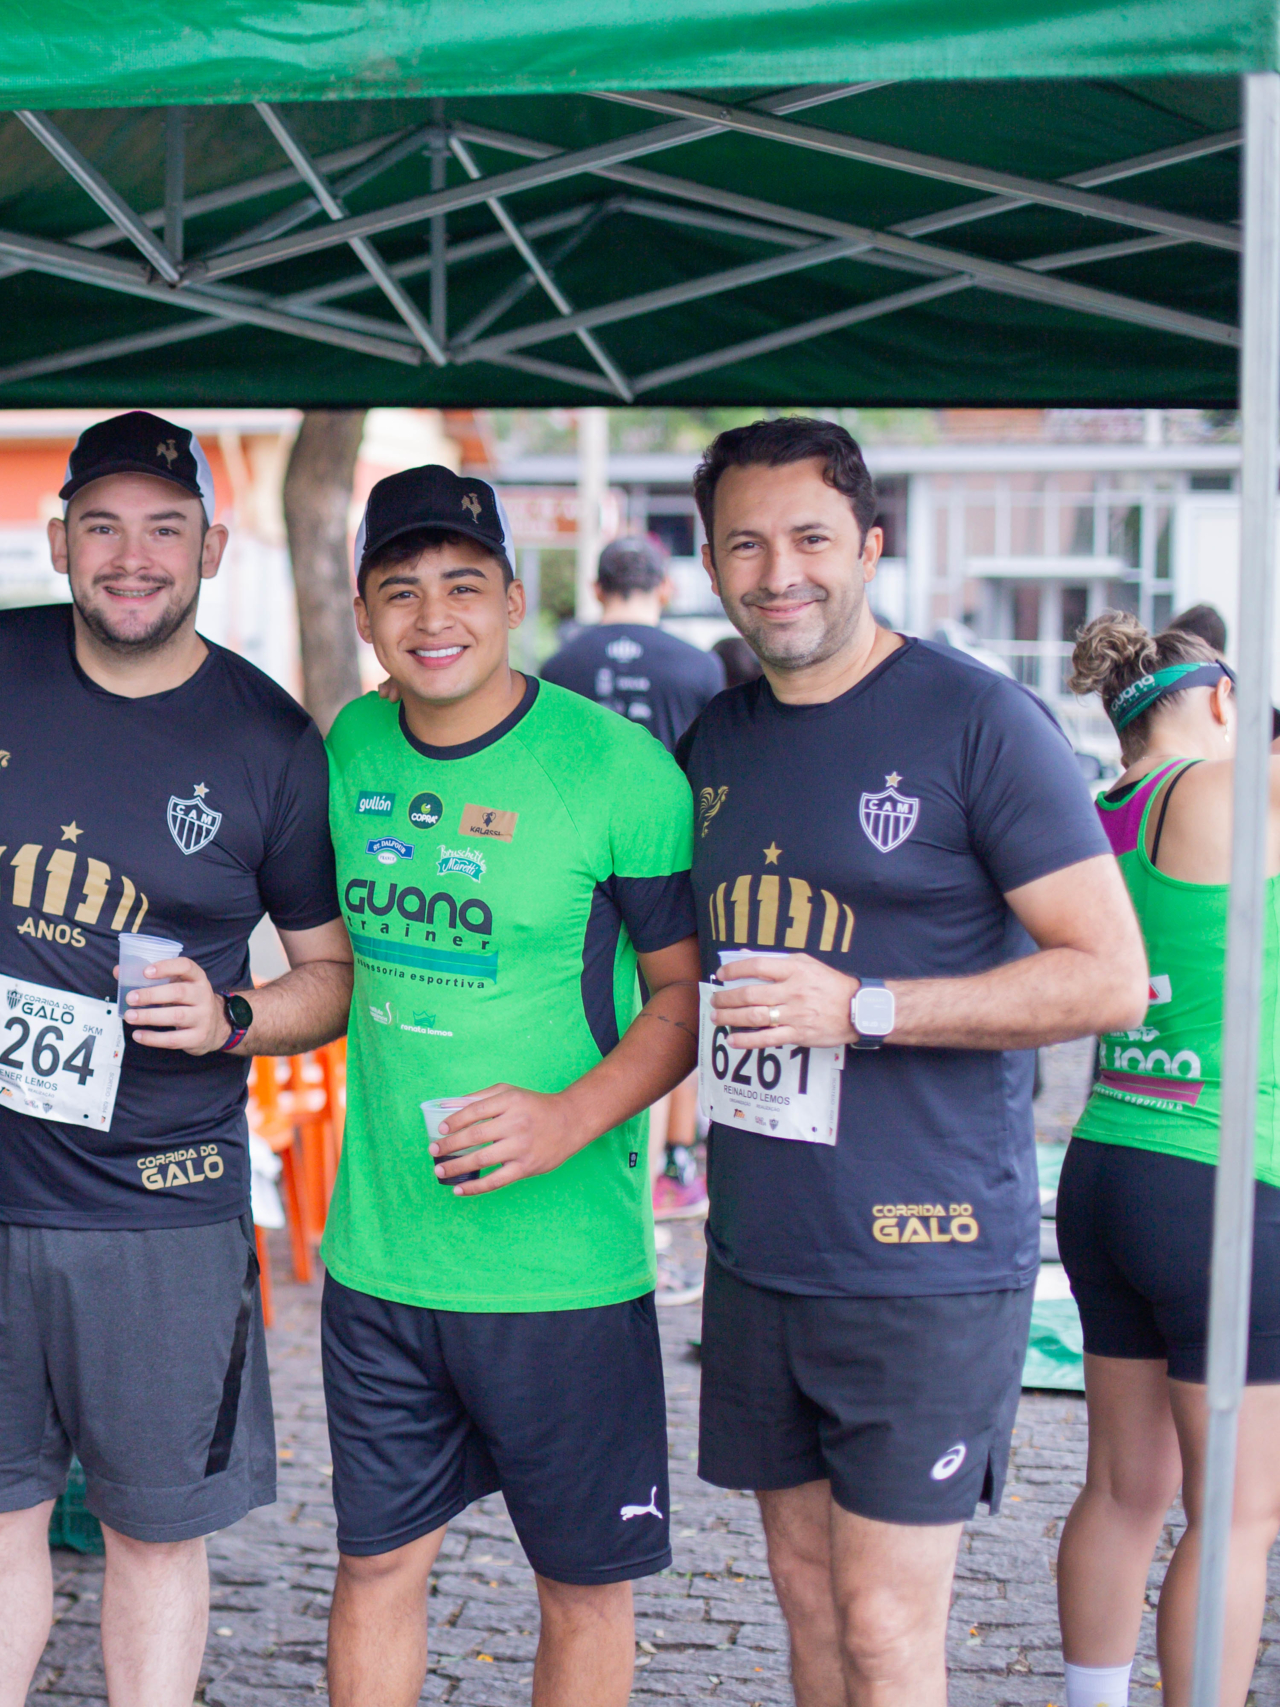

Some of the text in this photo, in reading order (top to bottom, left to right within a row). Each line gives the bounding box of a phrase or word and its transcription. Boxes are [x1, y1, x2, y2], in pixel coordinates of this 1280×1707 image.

[175, 804, 213, 825] CAM
[359, 795, 392, 814] gullón
[868, 798, 911, 815] CAM
[381, 840, 406, 855] DALFOUR
[17, 917, 87, 948] ANOS
[346, 914, 491, 950] trainer
[410, 973, 486, 989] esportiva
[21, 1001, 76, 1025] GALO
[23, 994, 75, 1012] CORRIDA DO
[82, 1024, 104, 1036] 5KM
[711, 1025, 812, 1095] 6261
[24, 1076, 59, 1092] LEMOS
[723, 1084, 791, 1106] REINALDO LEMOS
[136, 1143, 219, 1170] CORRIDA DO
[140, 1154, 226, 1191] GALO
[872, 1203, 973, 1218] CORRIDA DO
[872, 1216, 980, 1244] GALO
